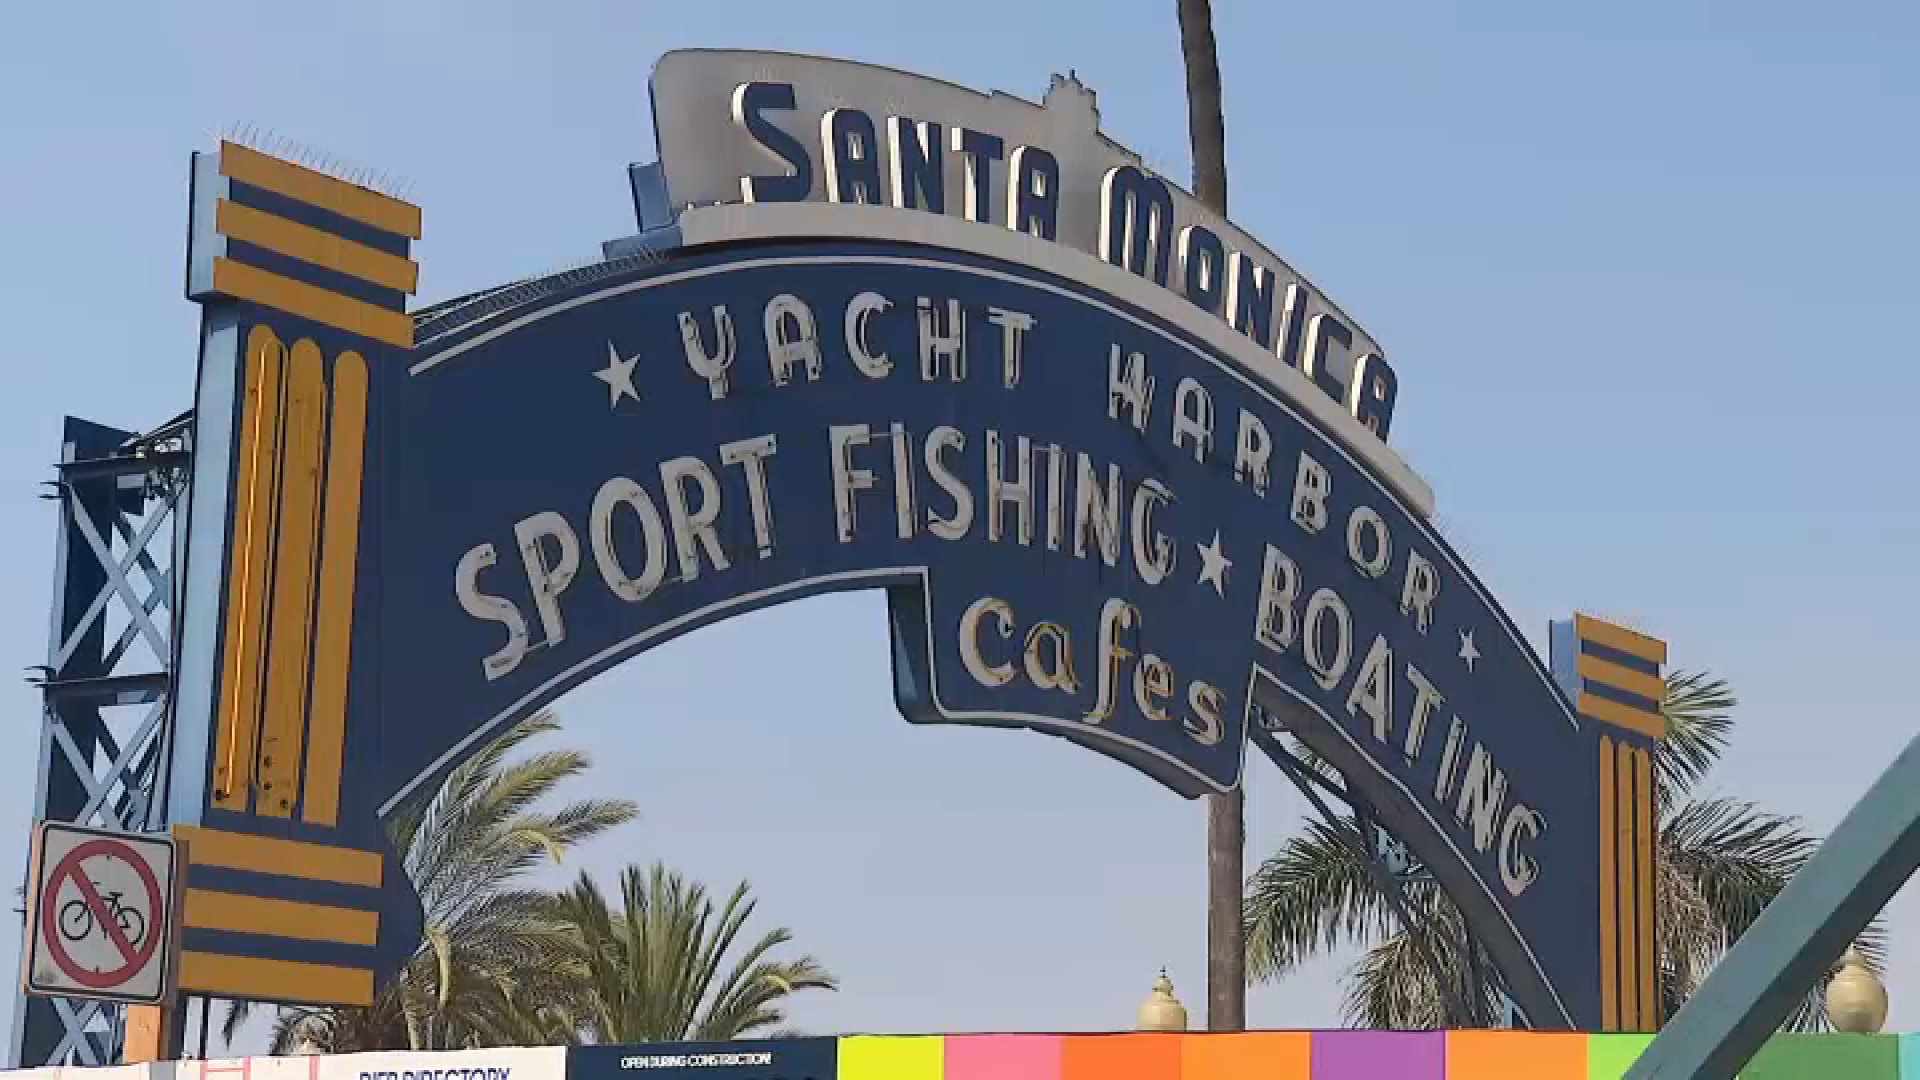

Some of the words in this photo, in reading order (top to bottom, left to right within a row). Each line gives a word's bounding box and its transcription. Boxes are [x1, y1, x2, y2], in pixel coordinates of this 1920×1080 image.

[732, 82, 1059, 241] SANTA
[1099, 165, 1398, 443] MONICA
[678, 291, 1037, 399] YACHT
[1108, 343, 1440, 634] HARBOR
[454, 433, 777, 681] SPORT
[828, 422, 1178, 585] FISHING
[1254, 544, 1542, 897] BOATING
[620, 1056, 648, 1069] OPEN
[687, 1052, 772, 1067] CONSTRUCTION
